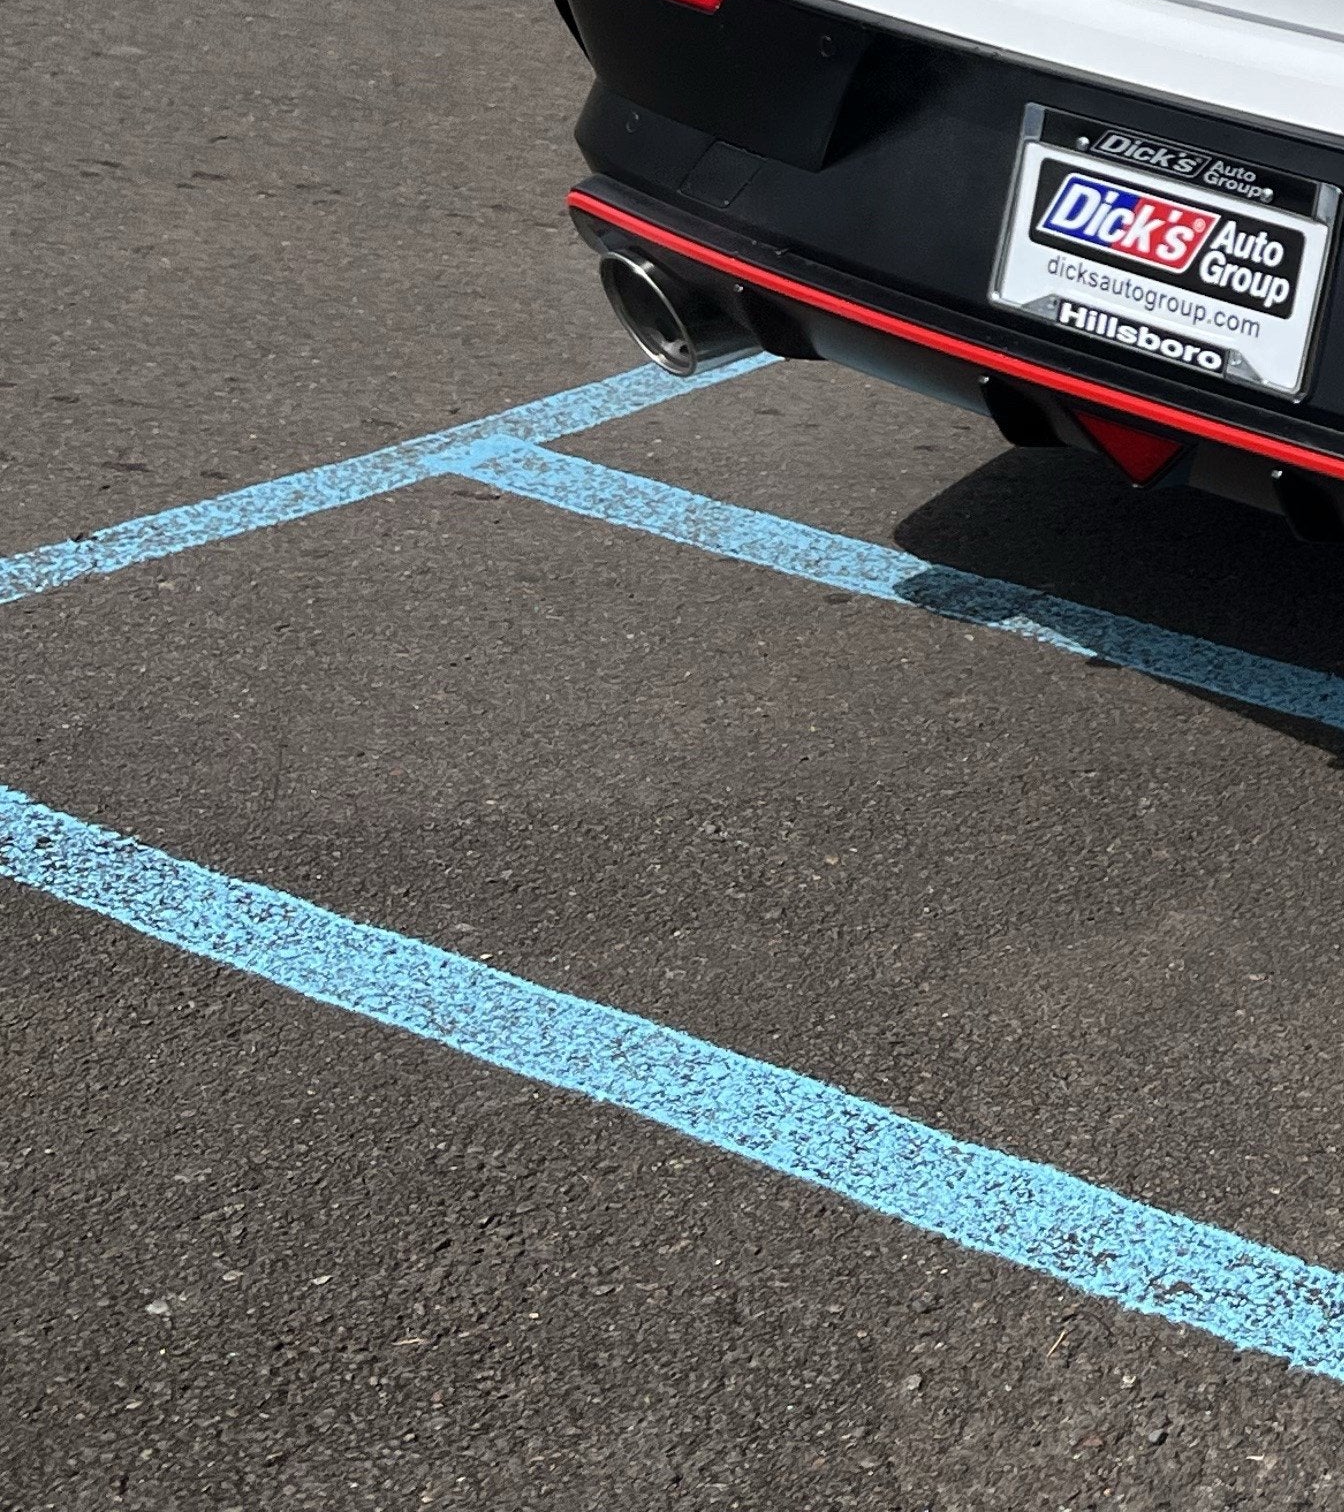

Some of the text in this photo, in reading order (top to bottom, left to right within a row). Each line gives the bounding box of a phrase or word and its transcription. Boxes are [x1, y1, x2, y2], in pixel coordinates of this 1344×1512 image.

[1100, 134, 1197, 173] Dick's
[1212, 160, 1257, 183] Auto
[1203, 169, 1265, 198] Group
[1210, 219, 1284, 268] Auto
[1047, 255, 1261, 338] dicksautogroup.com
[1200, 250, 1290, 308] Group
[1059, 302, 1223, 370] Hillsboro
